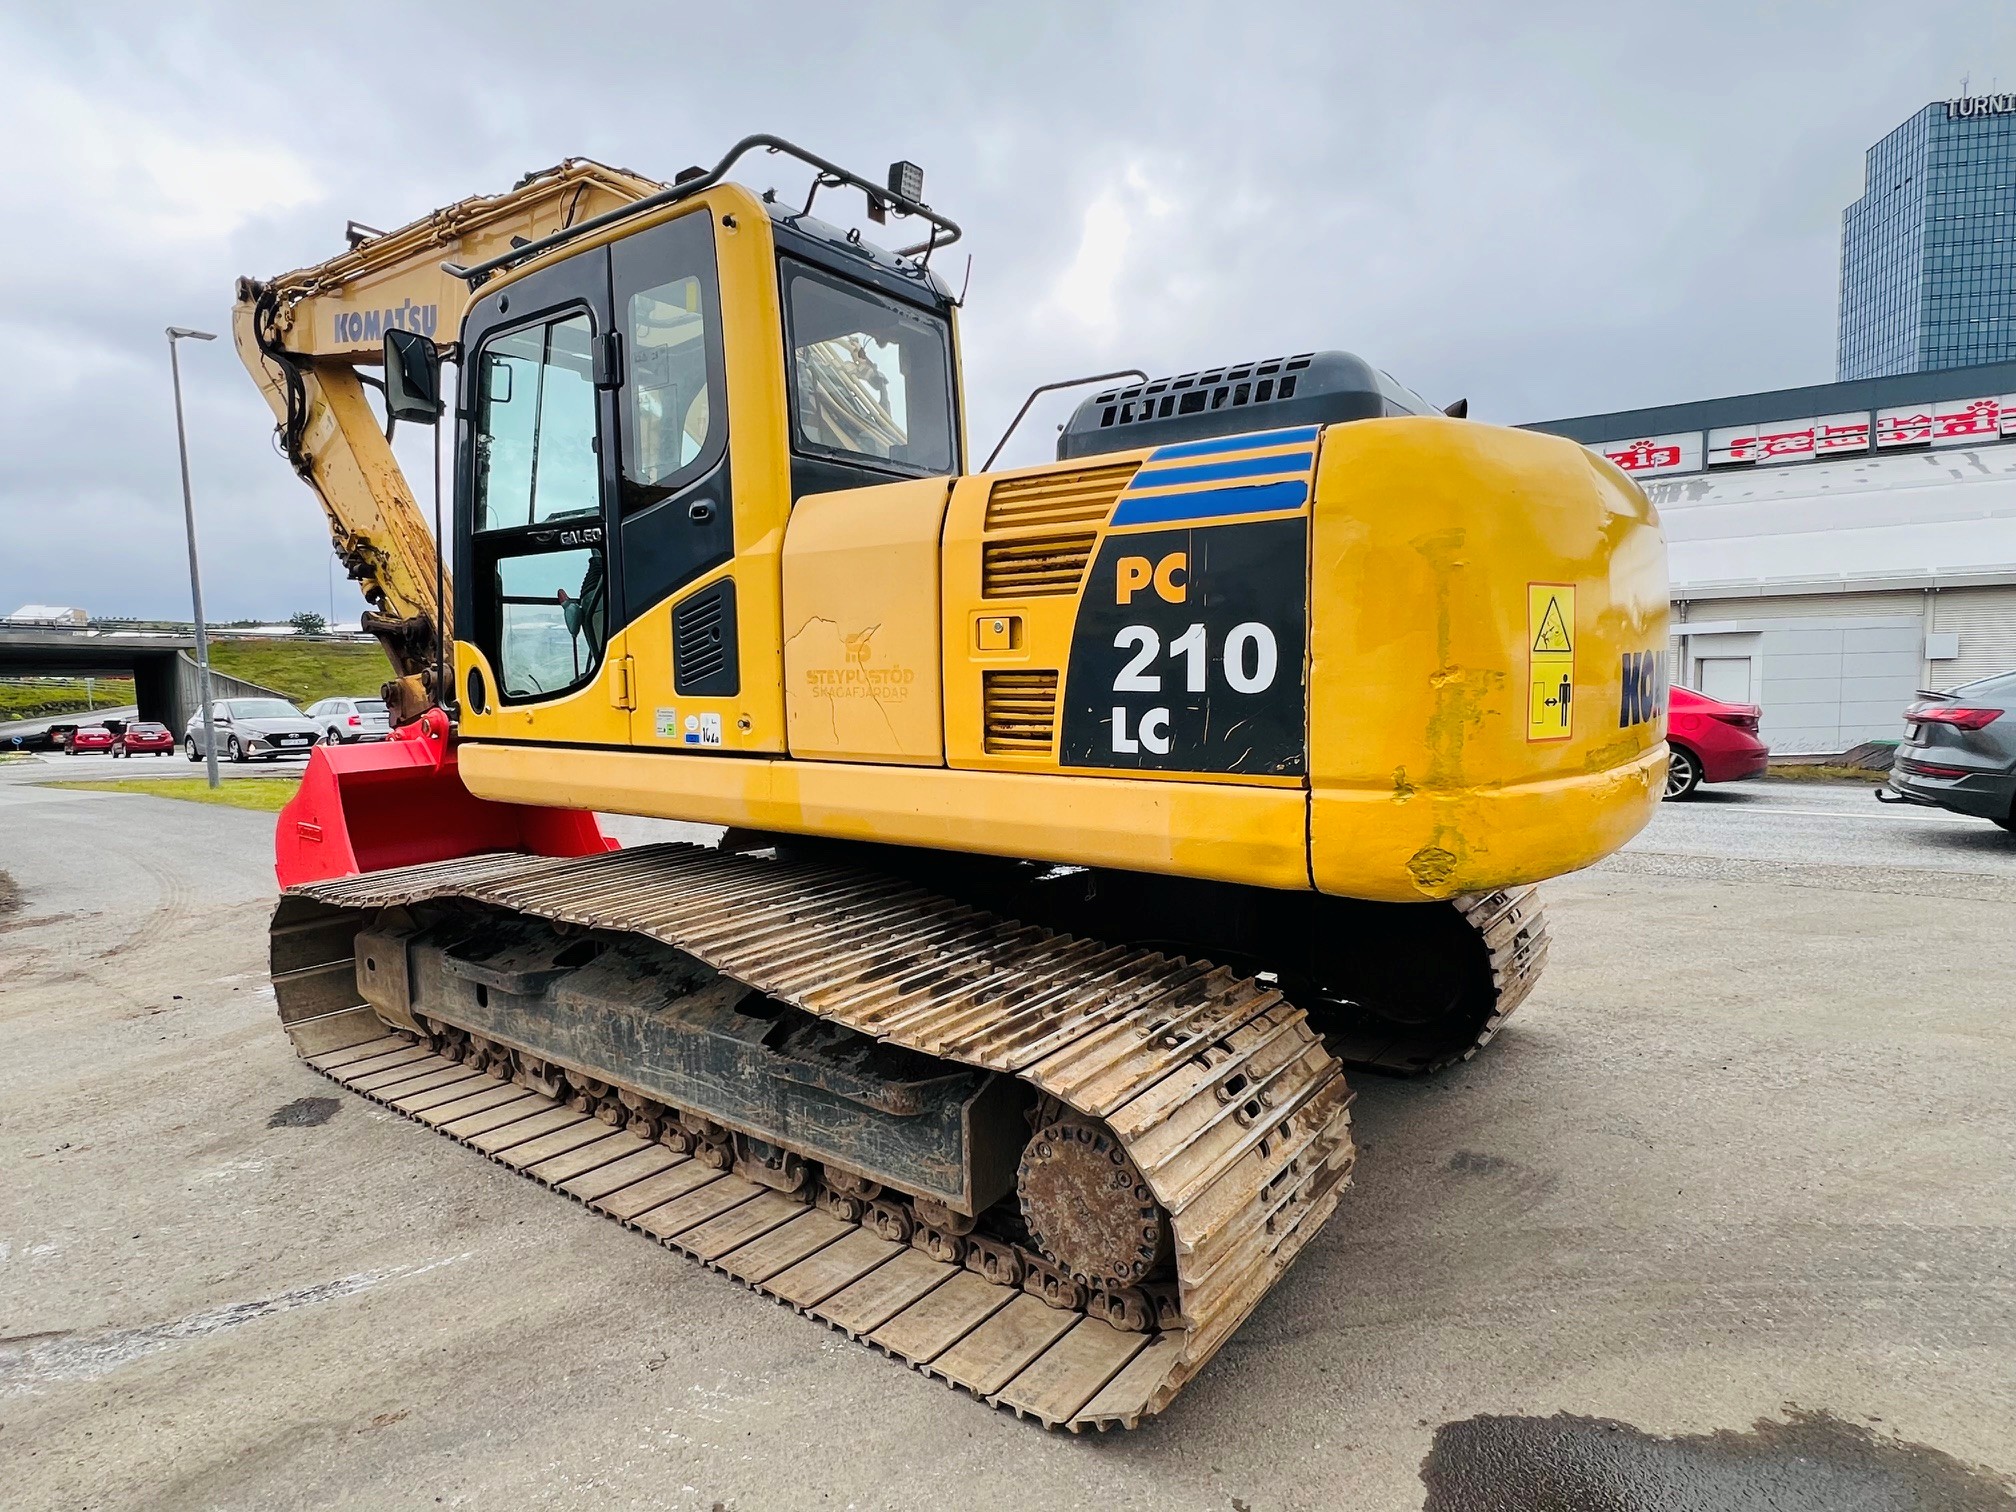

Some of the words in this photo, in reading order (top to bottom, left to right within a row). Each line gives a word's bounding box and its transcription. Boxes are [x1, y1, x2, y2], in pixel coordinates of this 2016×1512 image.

[334, 298, 437, 343] KOMATSU
[1116, 552, 1187, 605] PC
[1112, 621, 1278, 694] 210
[1112, 706, 1170, 754] LC
